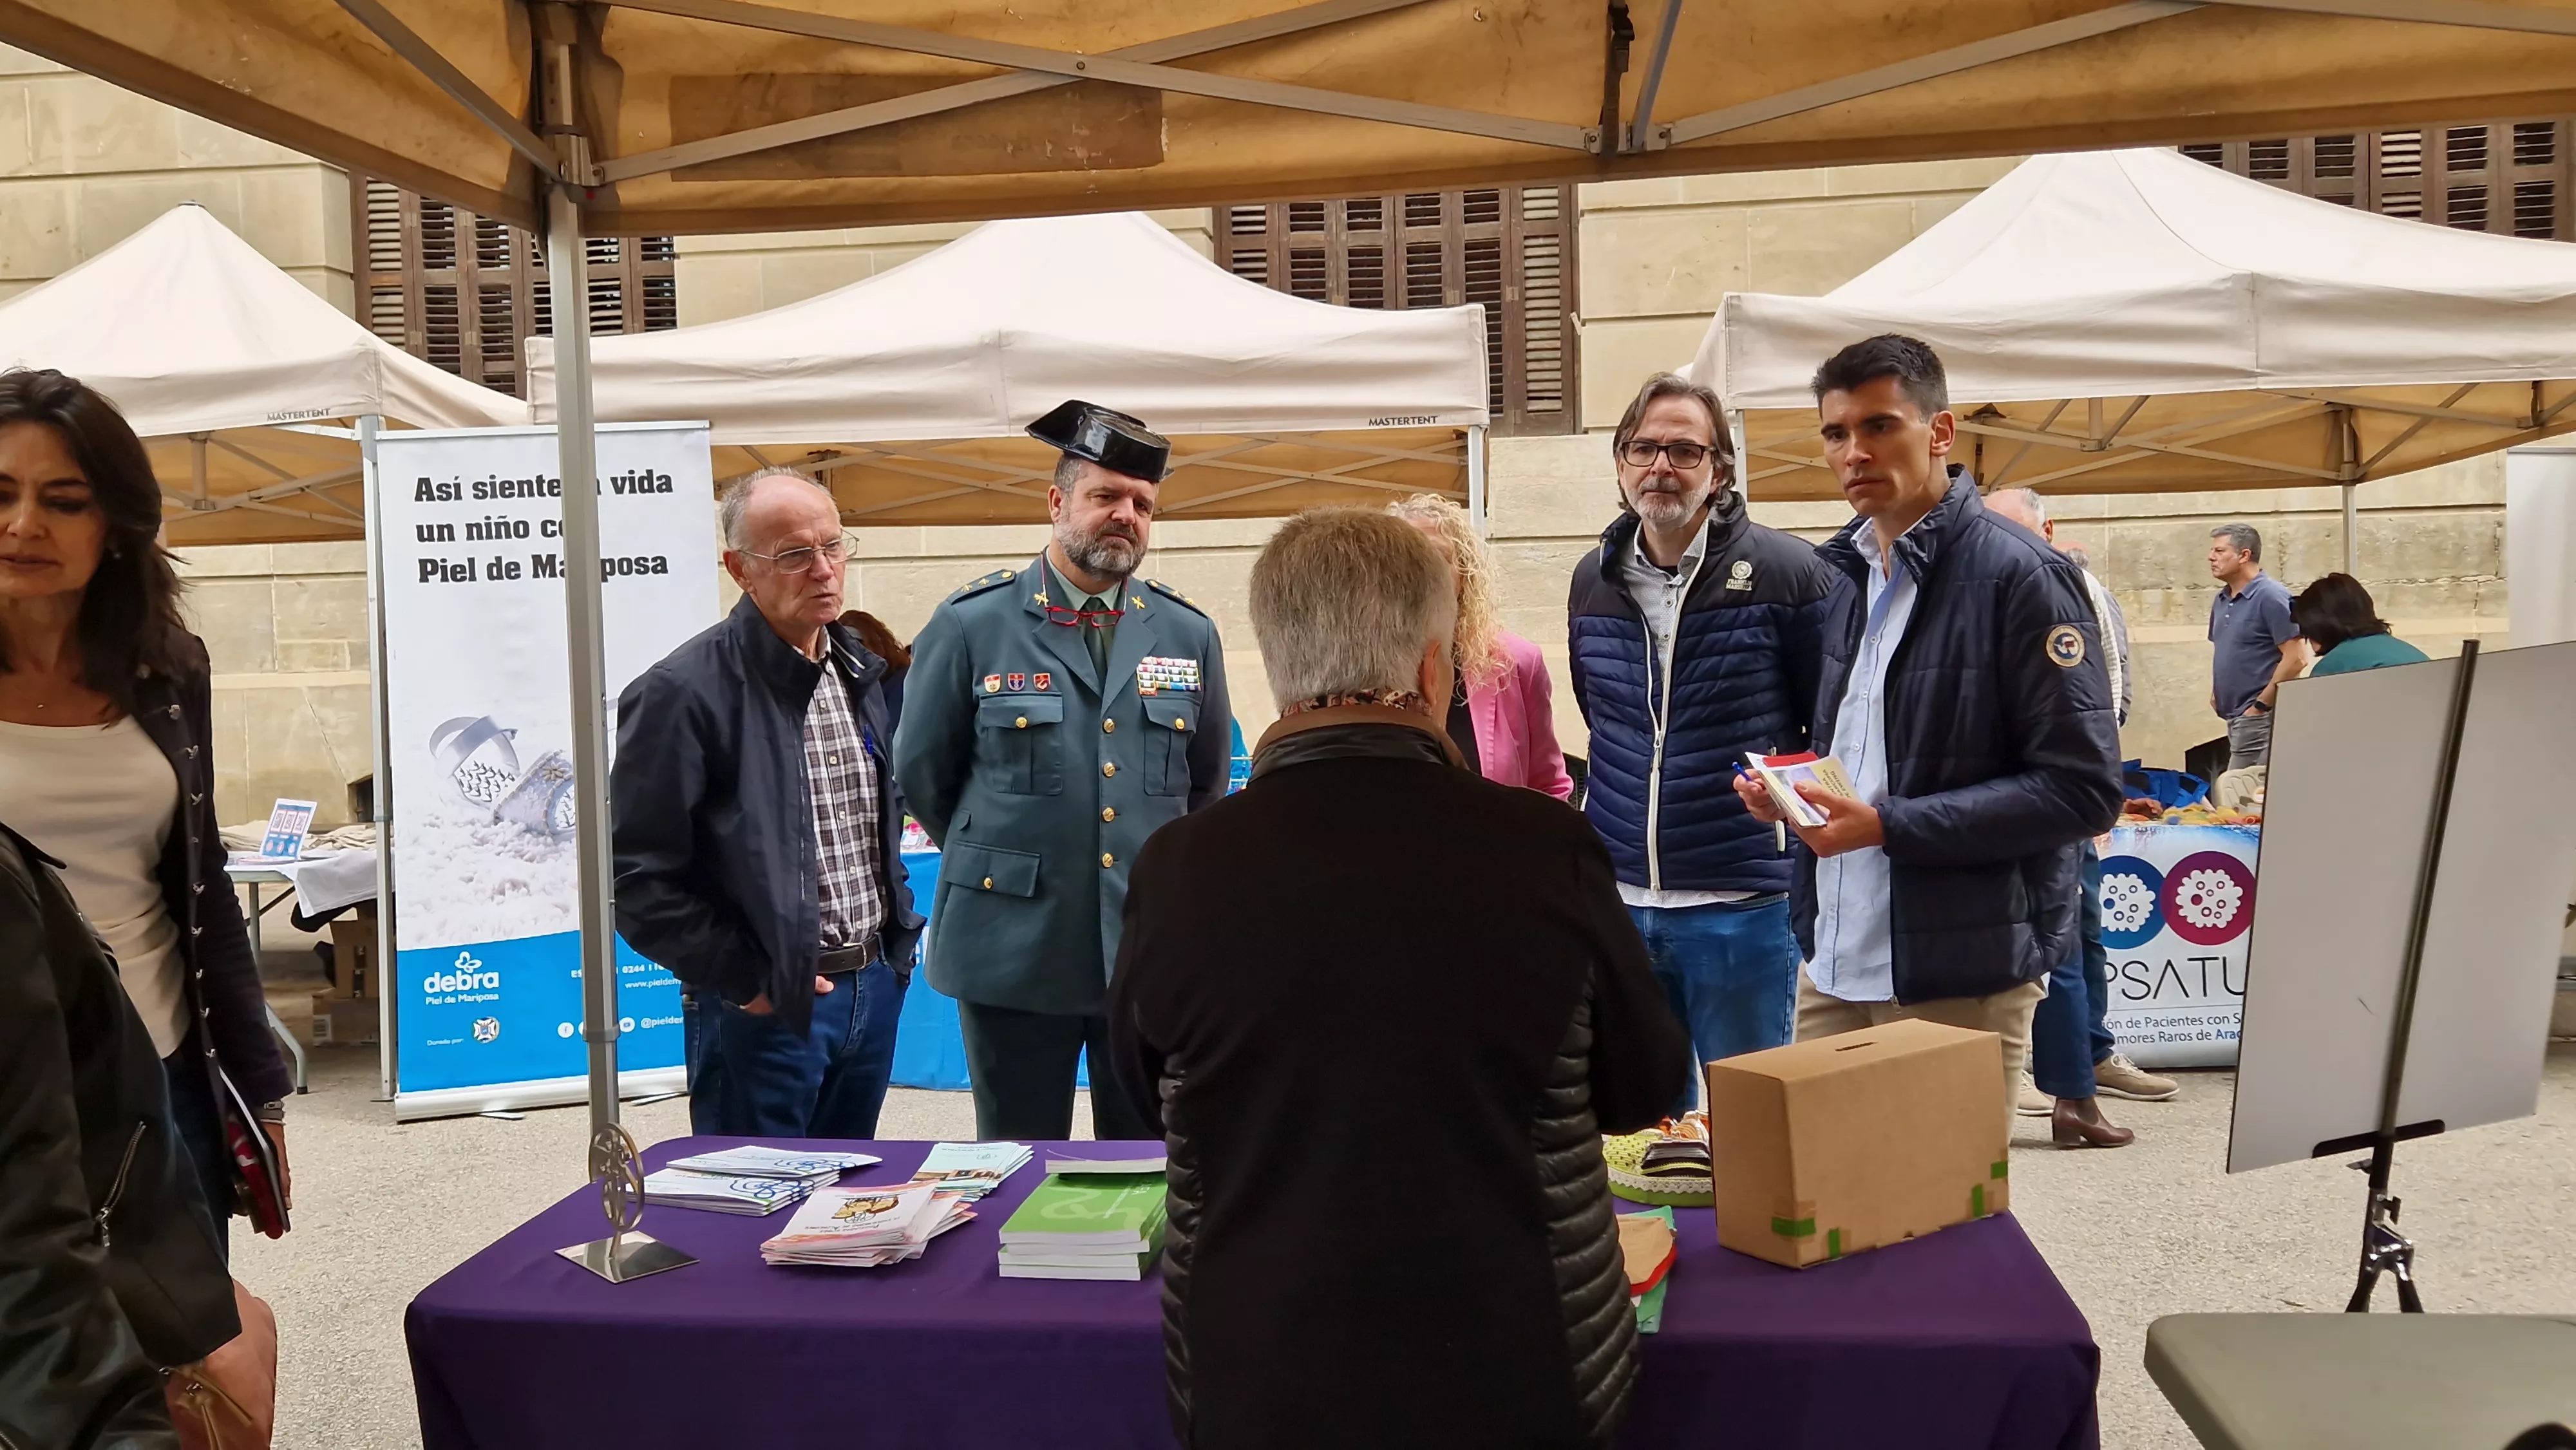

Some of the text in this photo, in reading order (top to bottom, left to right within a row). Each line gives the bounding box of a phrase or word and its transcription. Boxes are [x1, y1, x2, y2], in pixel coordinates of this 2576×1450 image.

[267, 408, 330, 421] MASTERTENT
[1368, 415, 1439, 426] MASTERTENT
[415, 476, 462, 502] Así
[472, 474, 561, 500] siente
[610, 469, 673, 494] vida
[415, 523, 456, 542] un
[466, 515, 530, 540] niño
[418, 557, 477, 583] Piel
[486, 556, 522, 581] de
[424, 970, 499, 993] debra
[426, 993, 499, 1005] Piel de Mariposa
[2126, 1017, 2142, 1029] de
[2145, 1016, 2204, 1028] Pacientes
[2207, 1015, 2230, 1025] con
[2114, 1034, 2155, 1045] mores
[2159, 1031, 2193, 1042] Raros
[2197, 1029, 2212, 1040] de
